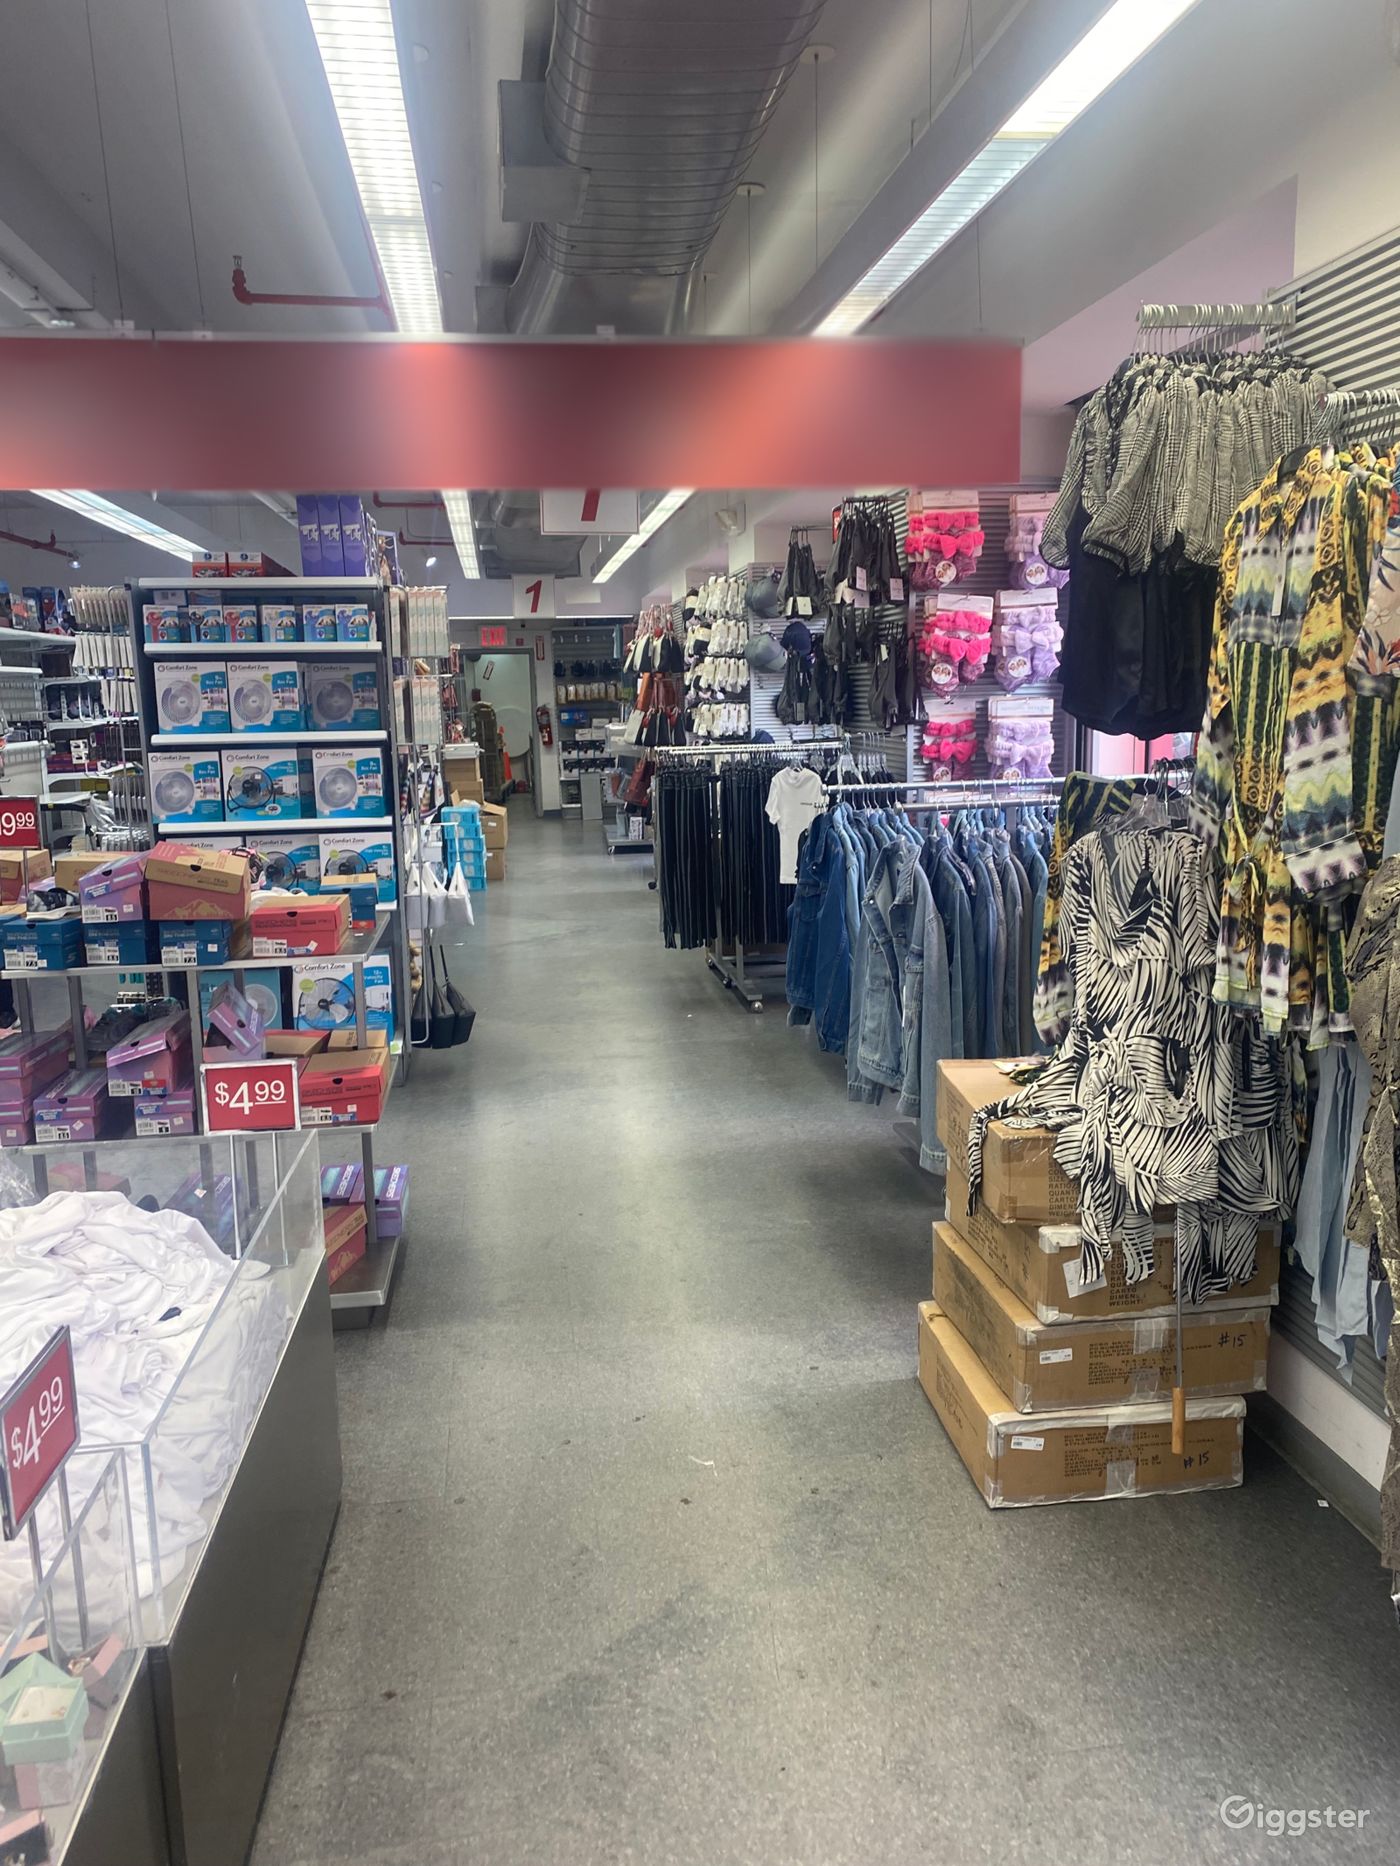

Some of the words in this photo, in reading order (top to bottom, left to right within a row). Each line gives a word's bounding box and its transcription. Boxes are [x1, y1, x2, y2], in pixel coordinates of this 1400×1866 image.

[525, 579, 542, 613] 1
[304, 963, 329, 971] Comfort
[330, 962, 346, 970] Zone
